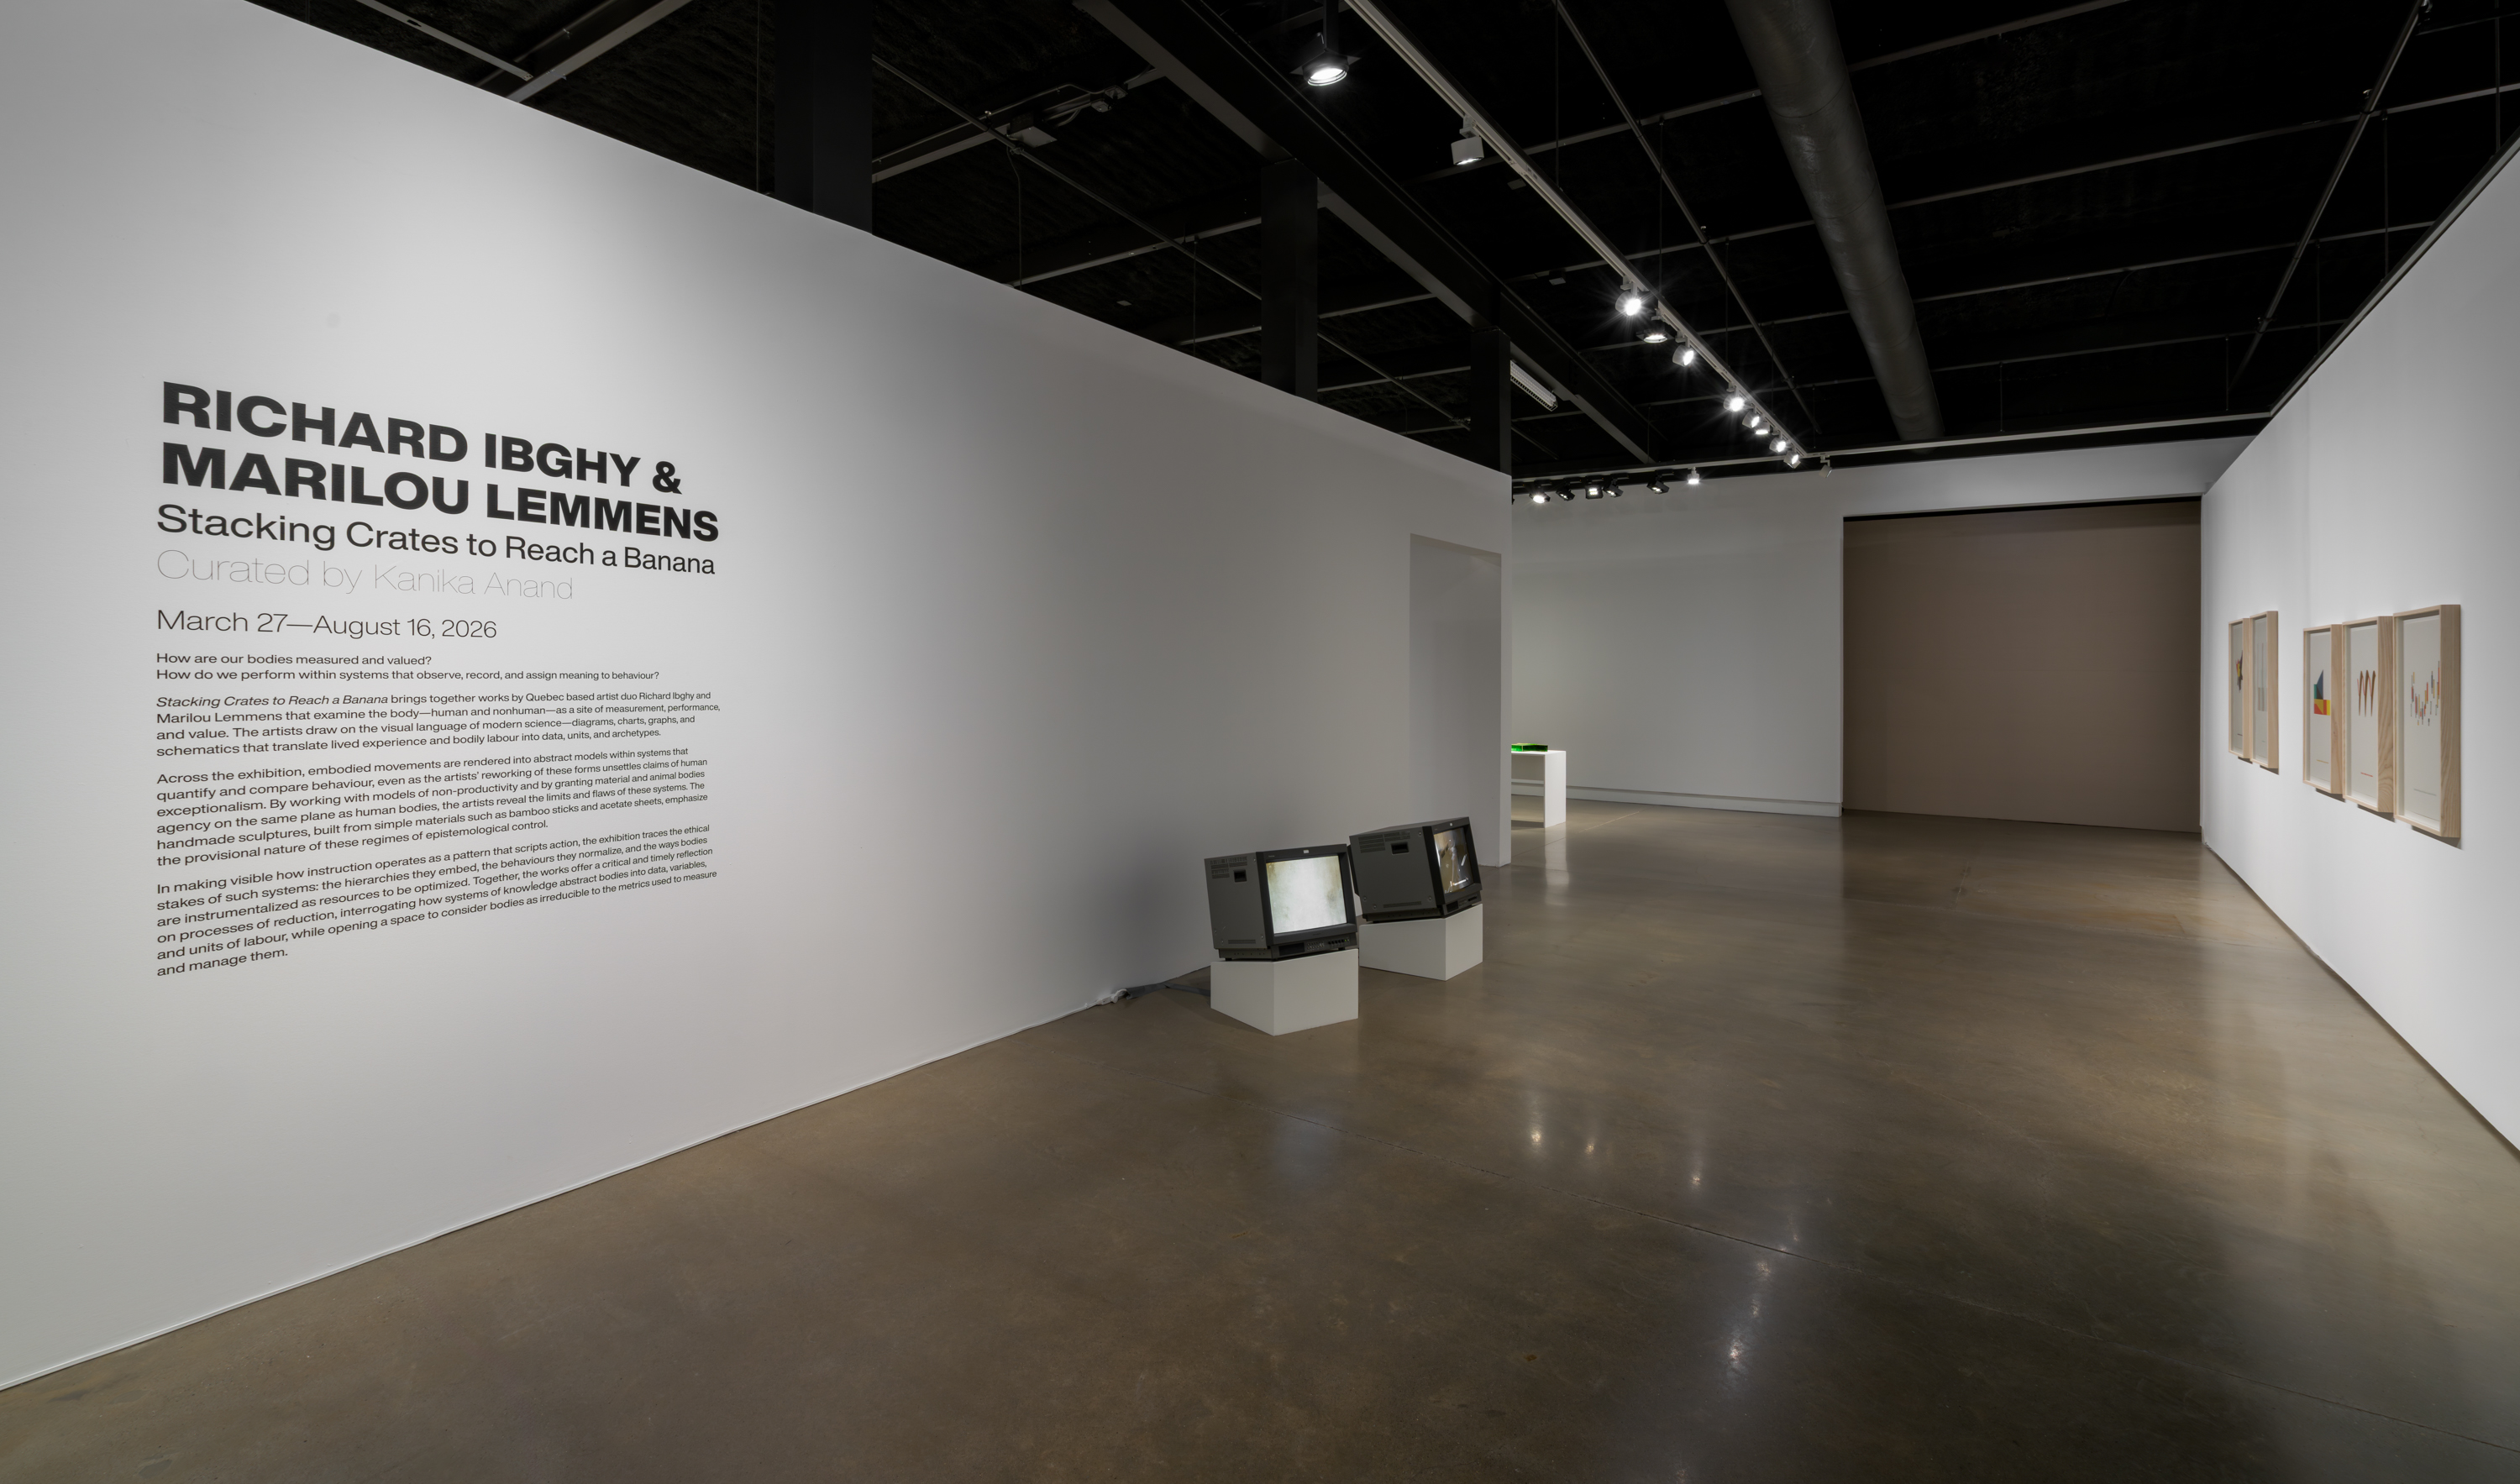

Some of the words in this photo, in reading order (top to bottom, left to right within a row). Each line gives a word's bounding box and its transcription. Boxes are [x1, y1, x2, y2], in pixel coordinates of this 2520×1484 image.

[163, 380, 468, 463] RICHARD
[485, 433, 642, 488] IBGHY
[652, 460, 683, 495] &
[162, 442, 469, 515] MARILOU
[486, 483, 719, 543] LEMMENS
[157, 504, 335, 552] Stacking
[346, 521, 459, 554] Crates
[465, 533, 497, 558] to
[506, 535, 595, 565] Reach
[601, 550, 618, 567] a
[624, 546, 716, 574] Banana
[157, 549, 309, 585] Curated
[323, 560, 363, 595] by
[375, 564, 476, 595] Kanika
[483, 572, 572, 600] Anand
[158, 609, 248, 632] March
[407, 618, 435, 640] 16,
[442, 619, 497, 638] 2026
[156, 653, 192, 663] How
[194, 655, 218, 663] are
[247, 654, 293, 664] bodies
[296, 655, 359, 665] measured
[361, 655, 385, 665] and
[386, 656, 432, 665] valued?
[156, 669, 192, 679] How
[194, 669, 213, 679] do
[241, 669, 296, 682] perform
[298, 669, 337, 679] within
[339, 670, 390, 682] systems
[391, 670, 414, 679] that
[416, 670, 464, 681] observe,
[465, 670, 502, 680] record,
[504, 670, 524, 679] and
[526, 671, 558, 681] assign
[559, 671, 599, 681] meaning
[612, 671, 659, 679] behaviour?
[155, 696, 221, 709] Stacking
[223, 695, 270, 706] Crates
[272, 696, 286, 705] to
[288, 695, 329, 705] Reach
[342, 695, 388, 705] Banana
[391, 695, 428, 705] brings
[428, 694, 476, 705] together
[477, 693, 510, 702] works
[512, 693, 524, 704] by
[525, 693, 564, 702] Quebec
[566, 692, 595, 701] based
[596, 692, 619, 701] artist
[620, 692, 638, 700] duo
[638, 692, 671, 700] Richard
[672, 691, 695, 701] Ibghy
[696, 691, 711, 700] and
[156, 713, 211, 724] Marilou
[214, 712, 283, 722] Lemmens
[285, 711, 311, 721] that
[313, 710, 366, 720] examine
[368, 709, 388, 719] the
[470, 706, 491, 716] and
[576, 705, 593, 714] site
[594, 705, 604, 714] of
[605, 704, 666, 713] measurement,
[667, 703, 721, 714] performance,
[156, 744, 240, 757] schematics
[242, 742, 270, 753] that
[271, 741, 328, 752] translate
[331, 738, 360, 749] lived
[362, 737, 428, 749] experience
[429, 735, 450, 746] and
[453, 734, 486, 746] bodily
[486, 733, 520, 743] labour
[522, 732, 540, 742] into
[541, 732, 566, 742] data,
[567, 731, 592, 740] units,
[593, 730, 611, 739] and
[612, 729, 661, 739] archetypes.
[156, 773, 209, 784] Across
[211, 771, 235, 781] the
[237, 768, 305, 780] exhibition,
[307, 763, 371, 776] embodied
[374, 760, 442, 772] movements
[443, 760, 461, 768] are
[463, 756, 511, 767] rendered
[512, 755, 532, 764] into
[533, 753, 573, 763] abstract
[574, 751, 608, 761] models
[609, 750, 636, 759] within
[637, 749, 672, 759] systems
[672, 747, 689, 756] that
[156, 801, 267, 817] exceptionalism.
[270, 799, 287, 810] By
[289, 795, 341, 807] working
[344, 793, 370, 803] with
[372, 789, 416, 801] models
[417, 788, 430, 798] of
[432, 783, 519, 797] non-productivity
[520, 780, 539, 790] and
[541, 780, 554, 791] by
[554, 778, 593, 790] granting
[595, 774, 630, 785] material
[631, 773, 648, 783] and
[649, 771, 677, 781] animal
[678, 770, 706, 779] bodies
[156, 856, 181, 867] the
[185, 847, 260, 866] provisional
[264, 844, 307, 856] nature
[308, 841, 322, 851] of
[324, 839, 360, 850] these
[361, 834, 410, 847] regimes
[412, 831, 423, 841] of
[425, 823, 510, 841] epistemological
[512, 819, 549, 831] control.
[157, 884, 171, 894] In
[174, 878, 227, 893] making
[229, 873, 274, 885] visible
[276, 870, 305, 880] how
[307, 863, 372, 877] instruction
[375, 857, 427, 871] operates
[428, 855, 442, 863] as
[453, 849, 491, 863] pattern
[492, 846, 513, 856] that
[514, 842, 549, 853] scripts
[549, 839, 580, 850] action,
[581, 836, 597, 846] the
[598, 832, 641, 844] exhibition
[642, 830, 669, 839] traces
[669, 827, 683, 836] the
[684, 824, 710, 835] ethical
[157, 934, 176, 943] on
[180, 923, 254, 943] processes
[256, 918, 270, 930] of
[274, 911, 338, 927] reduction,
[340, 900, 417, 918] interrogating
[418, 897, 443, 907] how
[444, 891, 490, 905] systems
[491, 886, 501, 897] of
[503, 880, 558, 895] knowledge
[559, 874, 597, 887] abstract
[599, 871, 629, 882] bodies
[630, 868, 647, 877] into
[647, 866, 669, 875] data,
[669, 860, 707, 872] variables,
